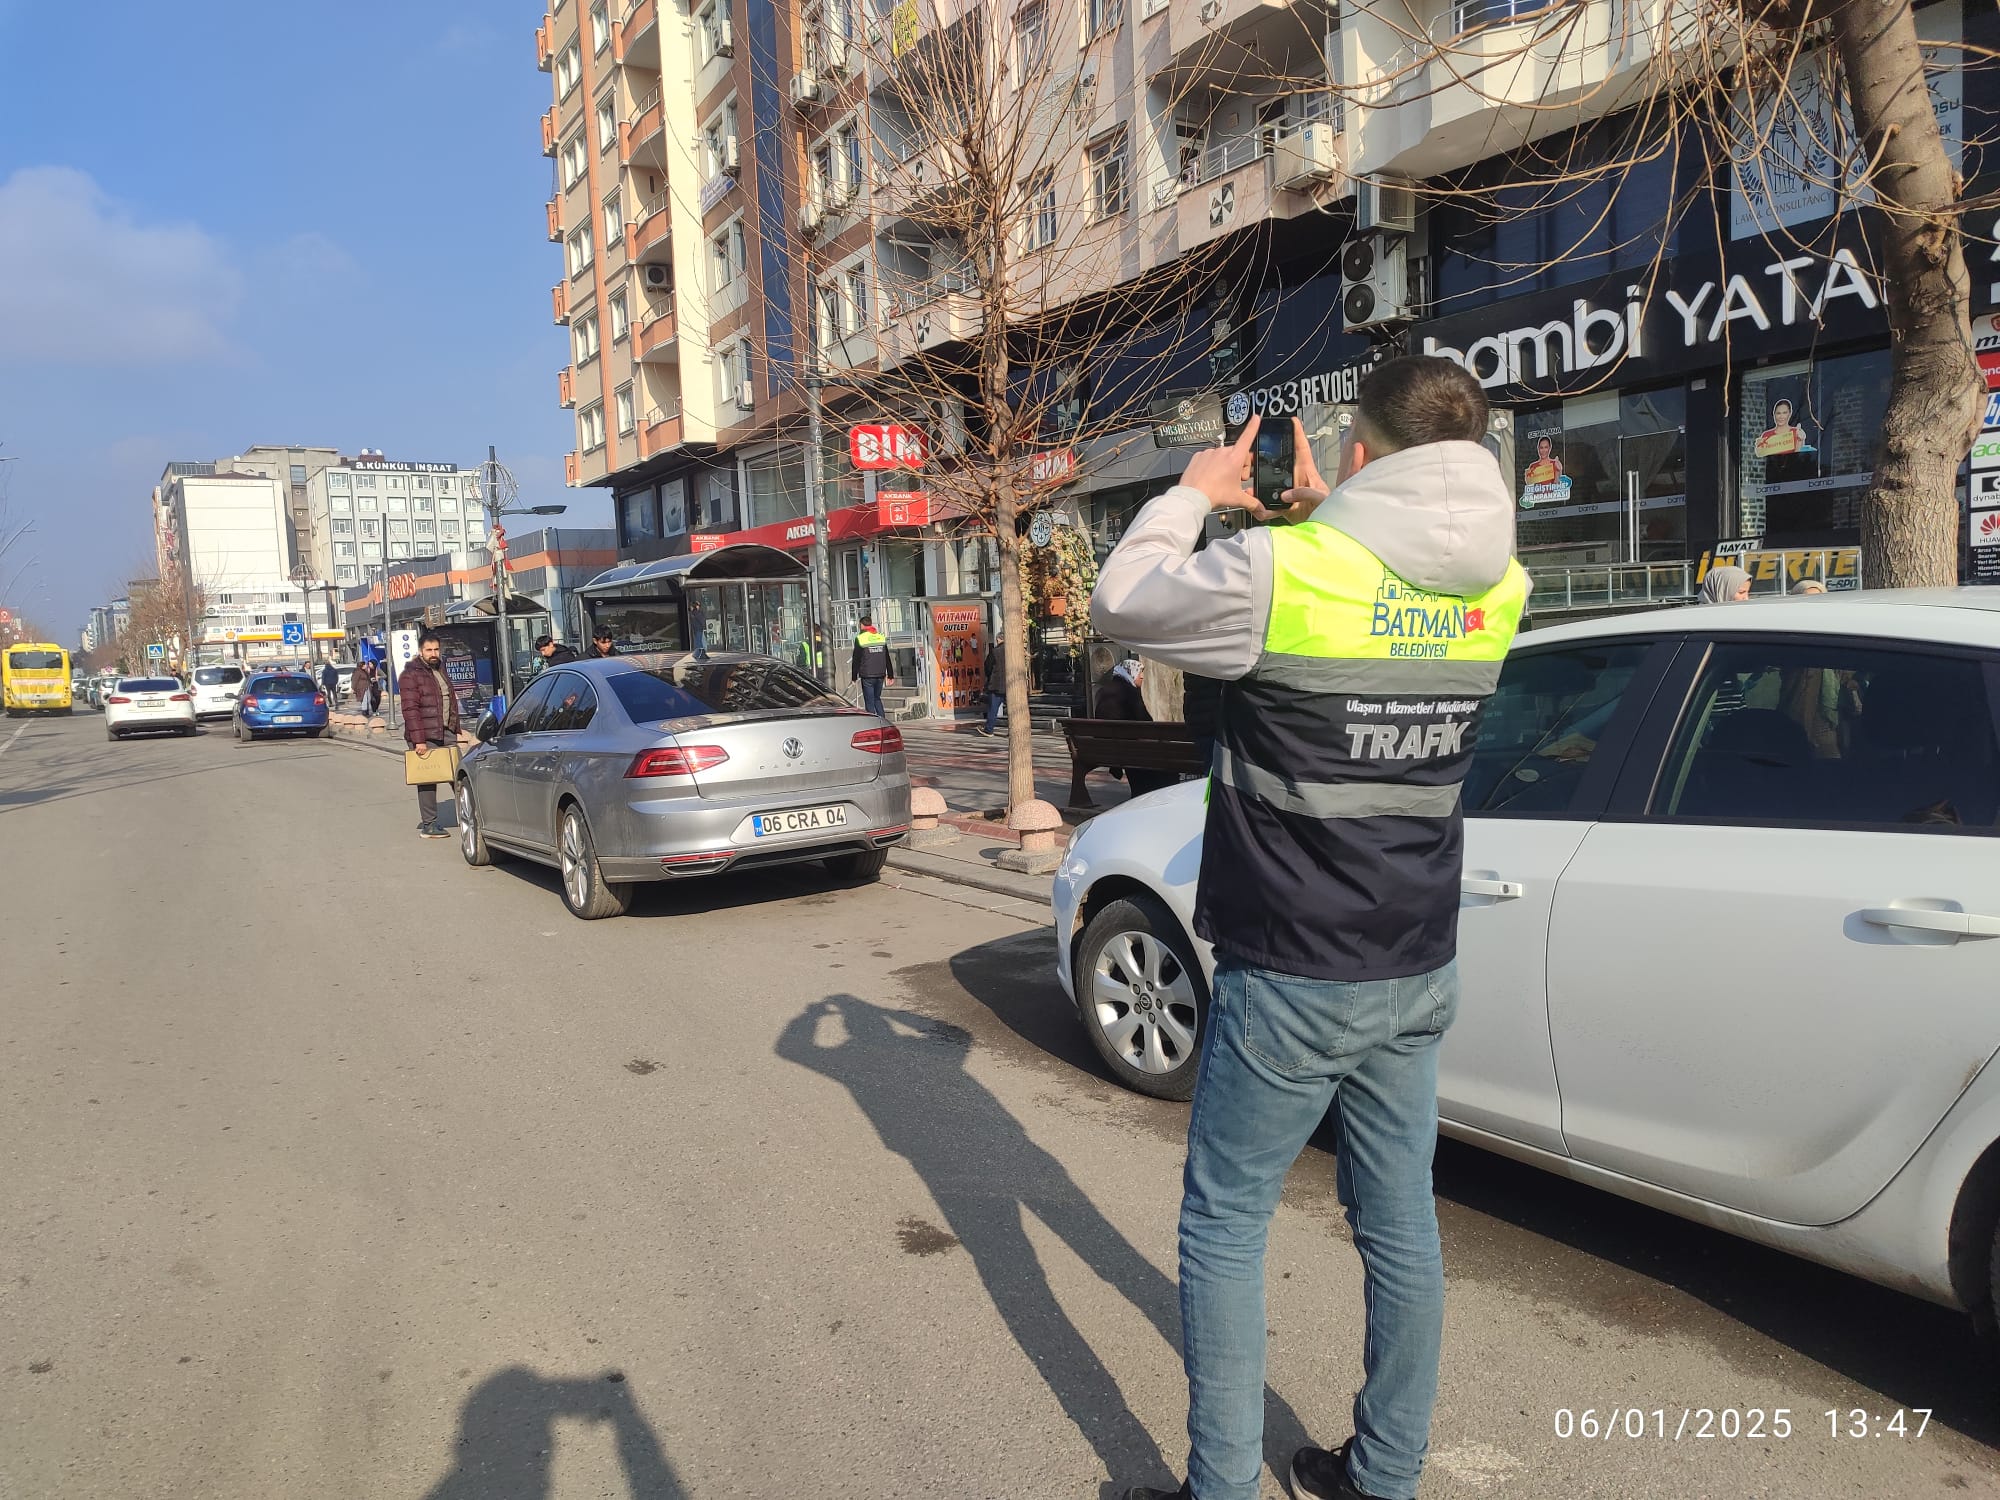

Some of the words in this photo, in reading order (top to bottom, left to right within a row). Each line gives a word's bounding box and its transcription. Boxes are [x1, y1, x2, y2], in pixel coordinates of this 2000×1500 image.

[1665, 248, 1887, 346] YATA
[1249, 381, 1299, 418] 1983
[858, 425, 922, 462] BİM
[786, 519, 831, 541] AKBAK
[1720, 541, 1755, 553] HAYAT
[943, 624, 969, 632] OUTLET
[1370, 602, 1468, 638] BATMAN
[1390, 640, 1449, 657] BELEDİYESİ
[1346, 700, 1382, 716] Ulaşım
[1386, 701, 1435, 714] Hizmetleri
[1346, 714, 1471, 760] TRAFİK
[763, 815, 782, 832] 06
[787, 811, 820, 830] CRA
[826, 808, 845, 825] 04
